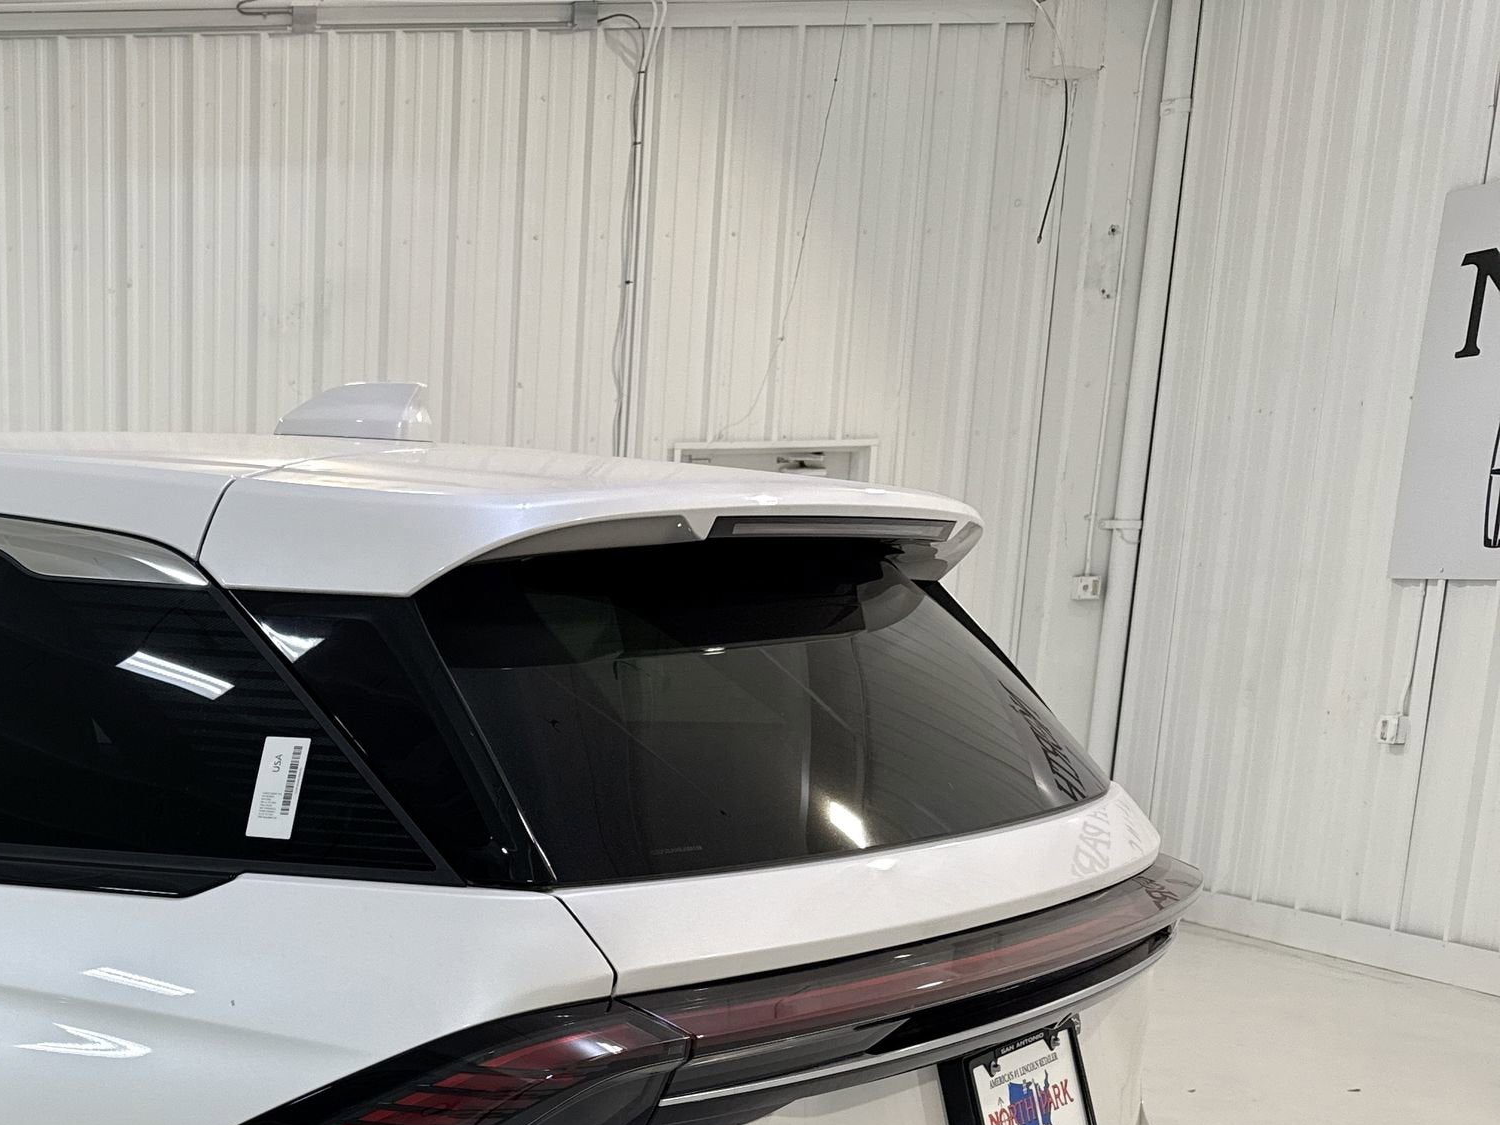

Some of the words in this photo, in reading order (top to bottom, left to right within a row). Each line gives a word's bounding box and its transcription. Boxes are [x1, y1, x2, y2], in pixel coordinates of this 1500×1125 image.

[272, 753, 284, 773] USA
[1000, 1043, 1015, 1055] SAN
[1016, 1032, 1045, 1048] ANTONIO
[1020, 1059, 1040, 1077] LINCOLN
[1037, 1078, 1075, 1114] PARK
